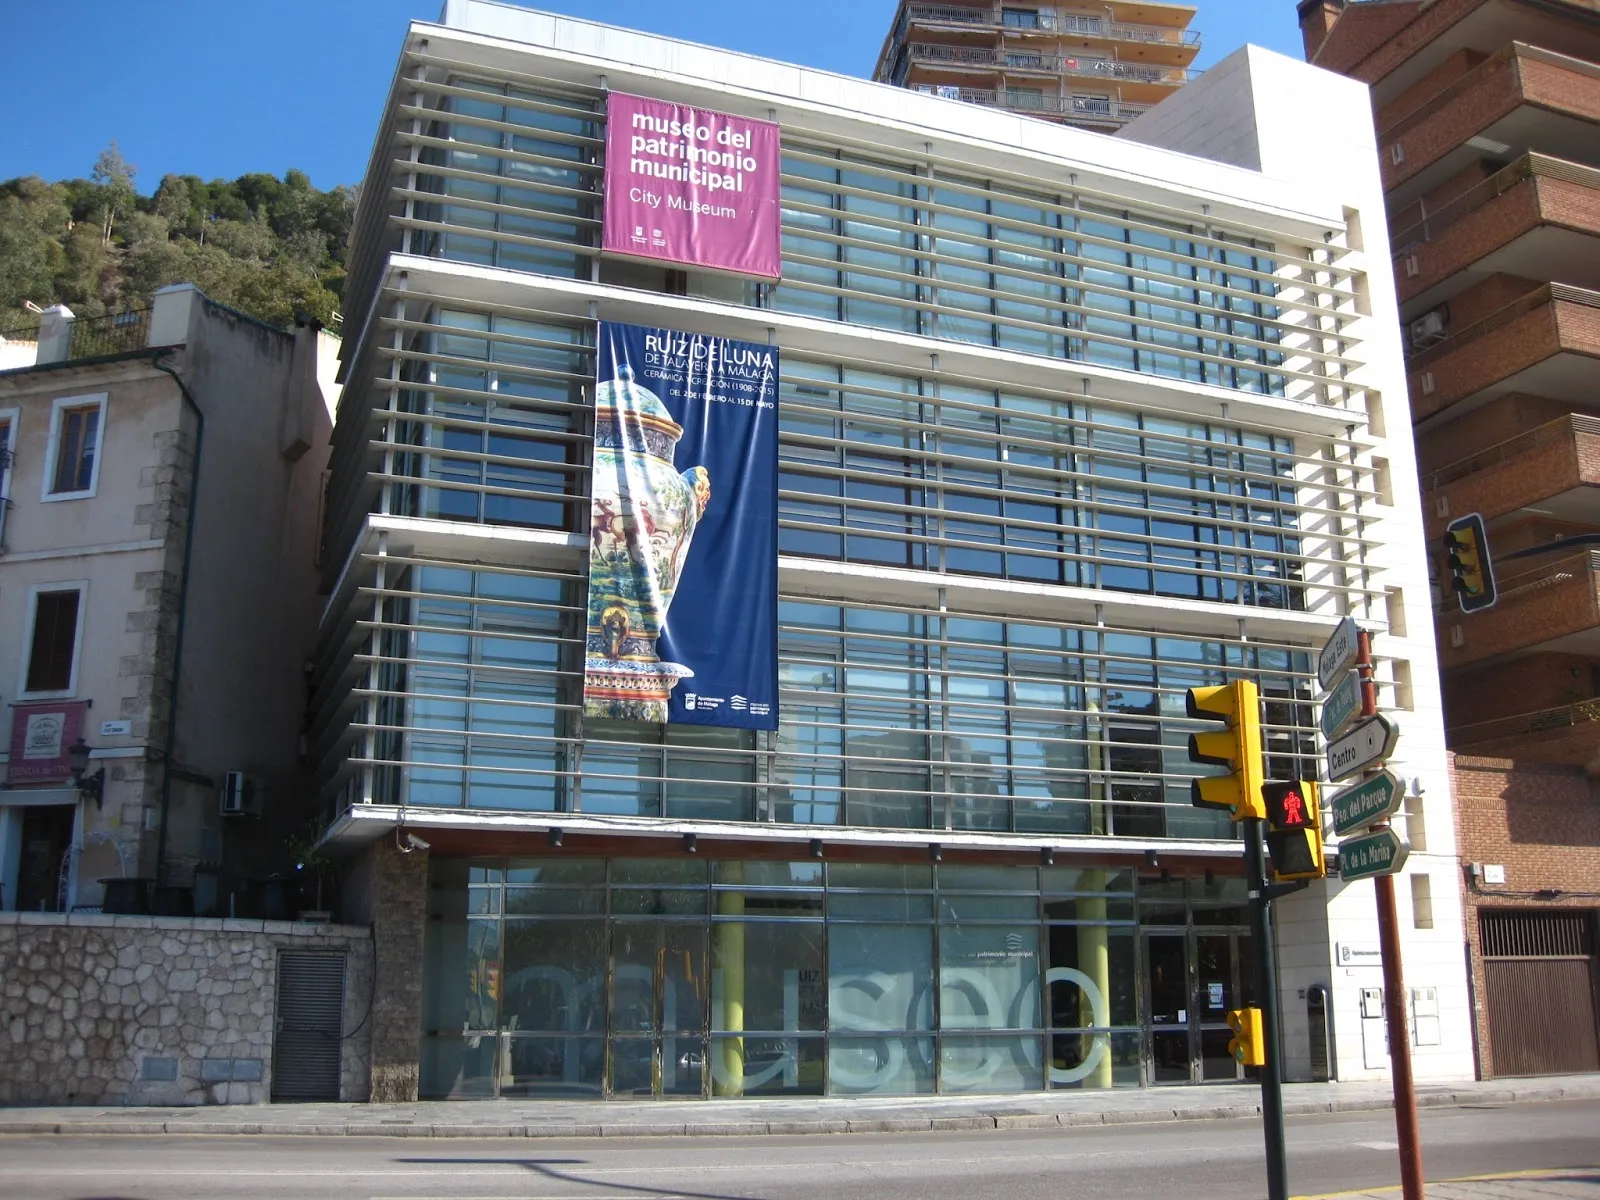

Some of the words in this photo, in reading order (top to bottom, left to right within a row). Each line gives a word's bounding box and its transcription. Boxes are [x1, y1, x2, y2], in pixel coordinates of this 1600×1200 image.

[632, 113, 710, 141] museo
[716, 126, 751, 150] del
[631, 135, 757, 172] patrimonio
[630, 157, 743, 192] municipal
[630, 188, 662, 209] City
[668, 195, 736, 219] Museum
[645, 353, 660, 364] DE
[663, 355, 715, 374] TALAVERA
[728, 365, 774, 381] MÁLAGA
[646, 335, 688, 356] RUIZ
[694, 344, 718, 361] DE
[724, 348, 774, 370] LUNA
[644, 369, 684, 382] CERÁMICA
[670, 388, 681, 397] DEL
[688, 391, 697, 399] DE
[728, 396, 736, 404] AL
[746, 399, 754, 407] DE
[755, 400, 774, 409] MAYO
[1331, 746, 1356, 770] Centro
[1349, 797, 1361, 818] del
[1361, 787, 1387, 812] Parque
[1350, 852, 1359, 868] de
[1360, 848, 1367, 866] la
[1369, 843, 1391, 864] Marina
